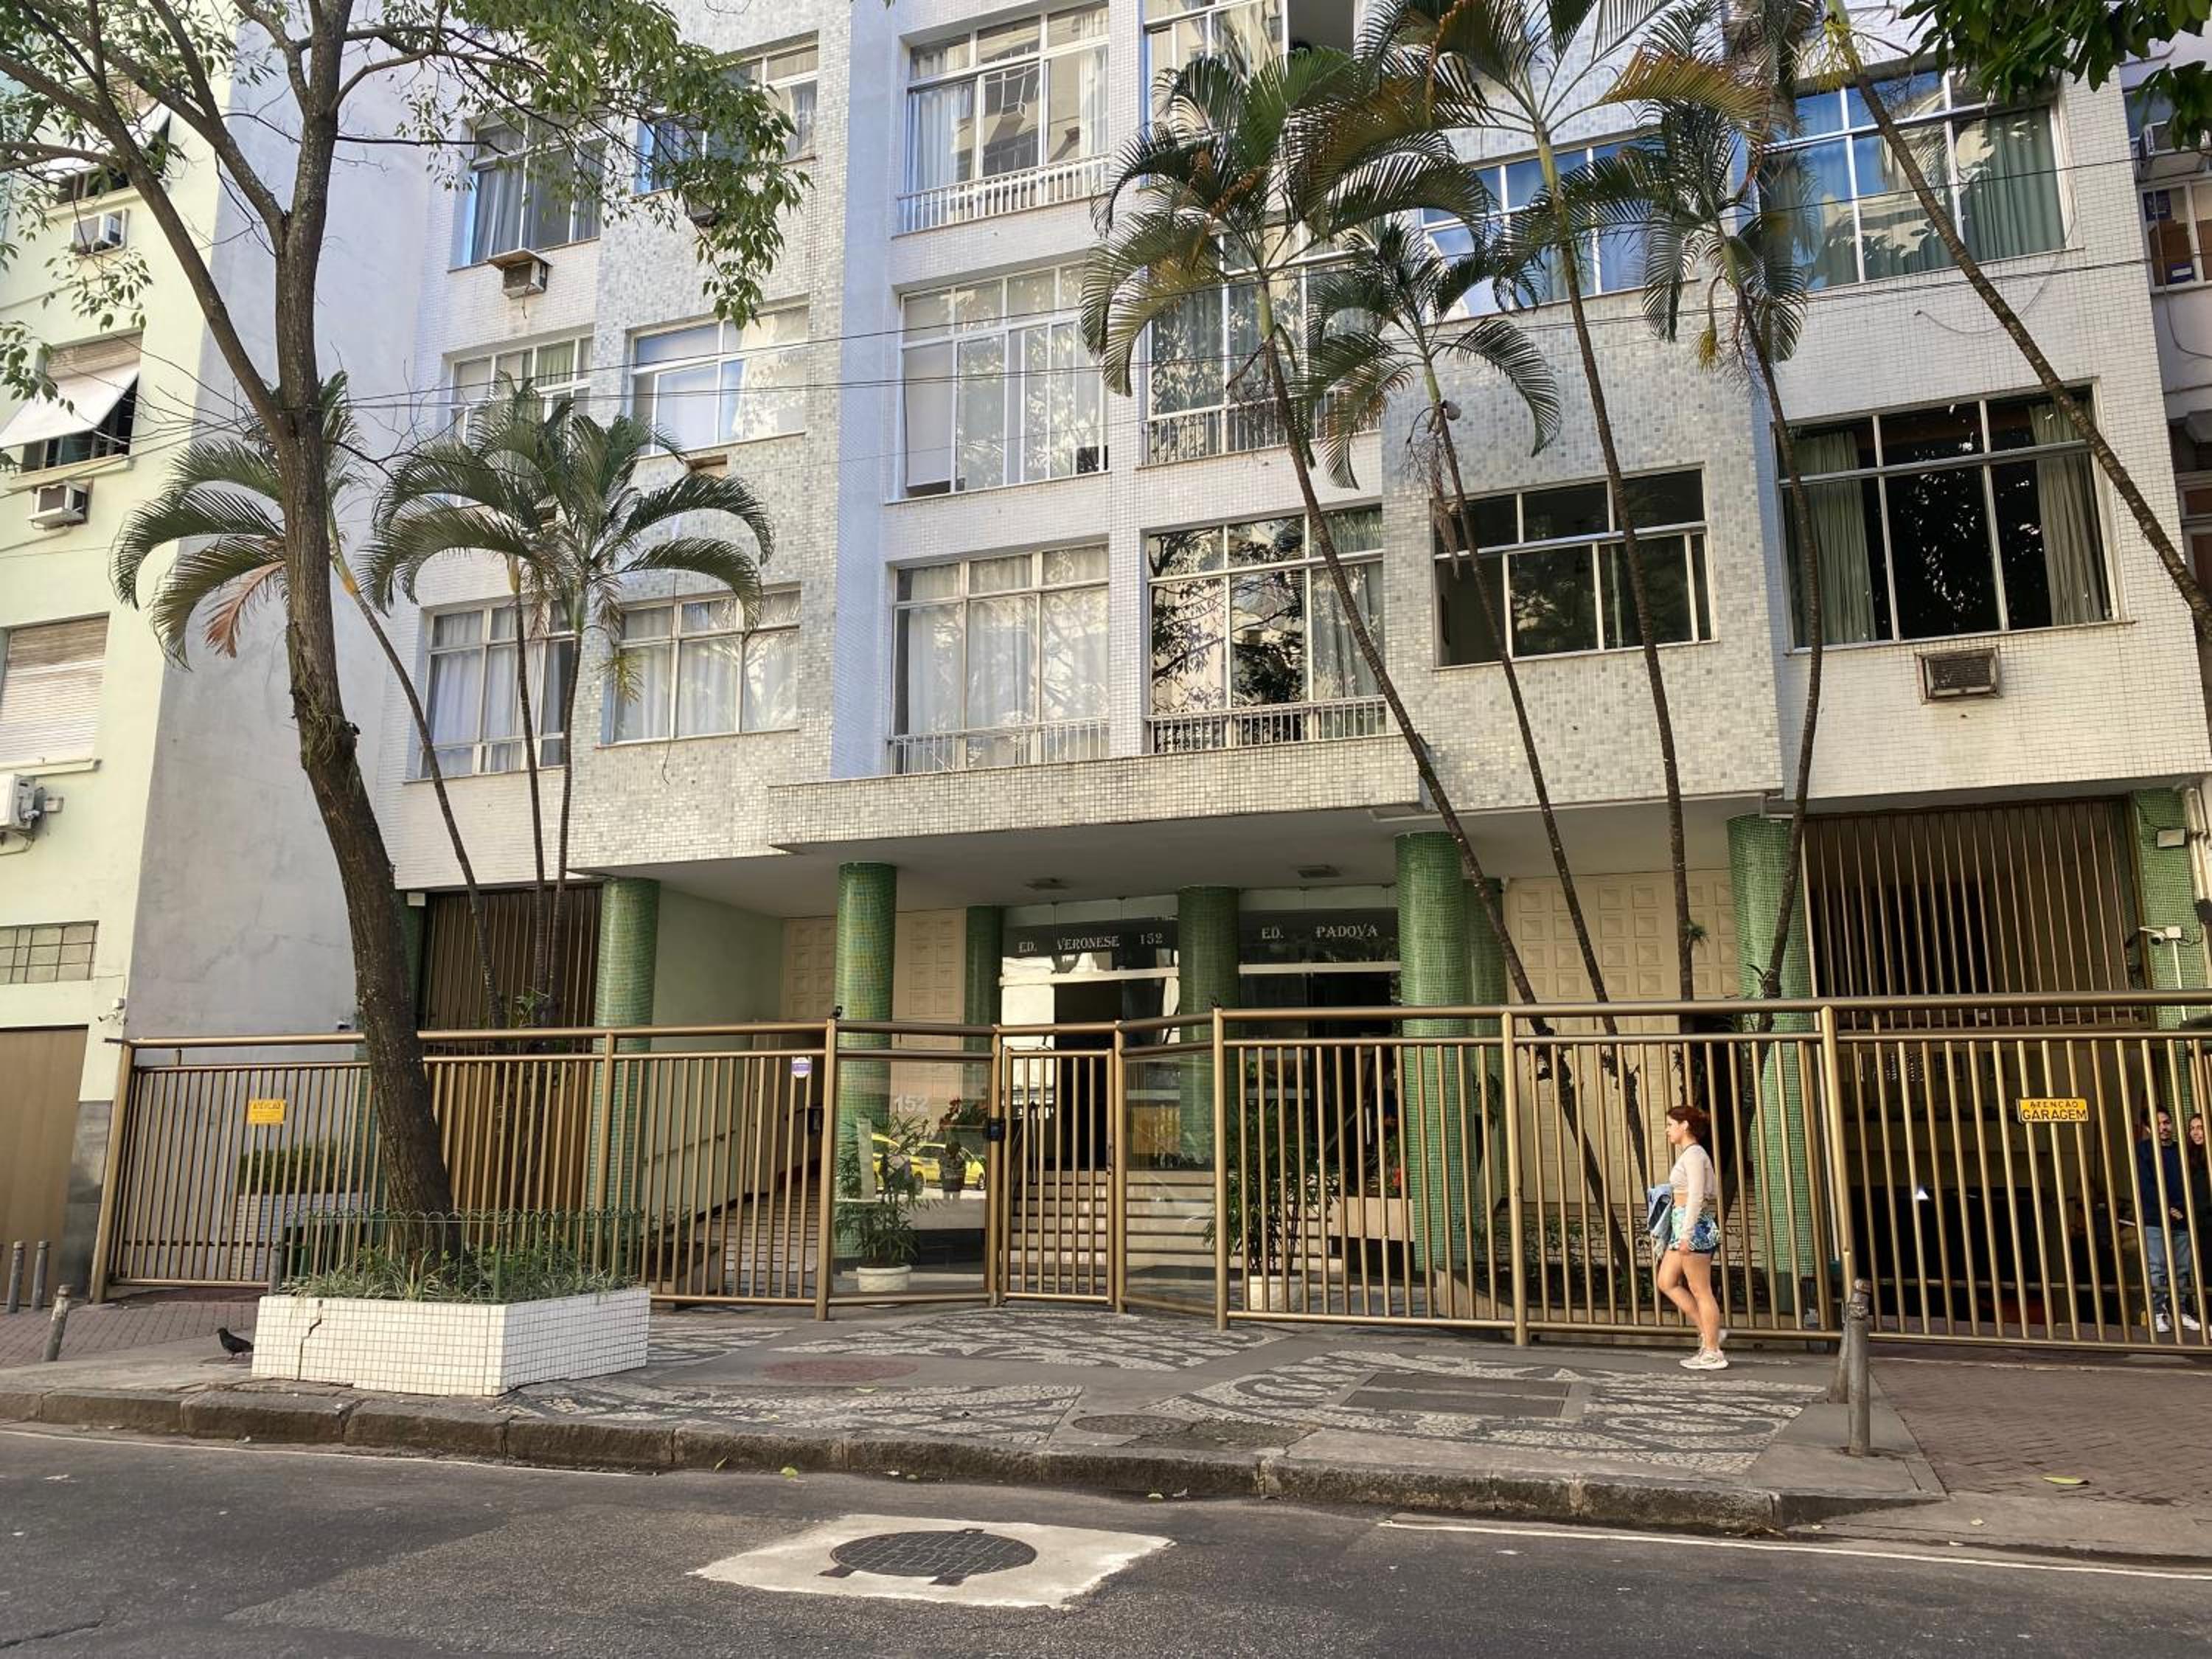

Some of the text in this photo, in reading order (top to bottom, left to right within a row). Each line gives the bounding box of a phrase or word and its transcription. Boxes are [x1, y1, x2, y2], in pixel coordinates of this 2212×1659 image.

[1262, 924, 1378, 939] ED. PADOVA
[1057, 935, 1120, 950] VERONESE
[1140, 933, 1163, 945] 152
[895, 1096, 928, 1112] 152
[2023, 1109, 2087, 1120] GARAGEM
